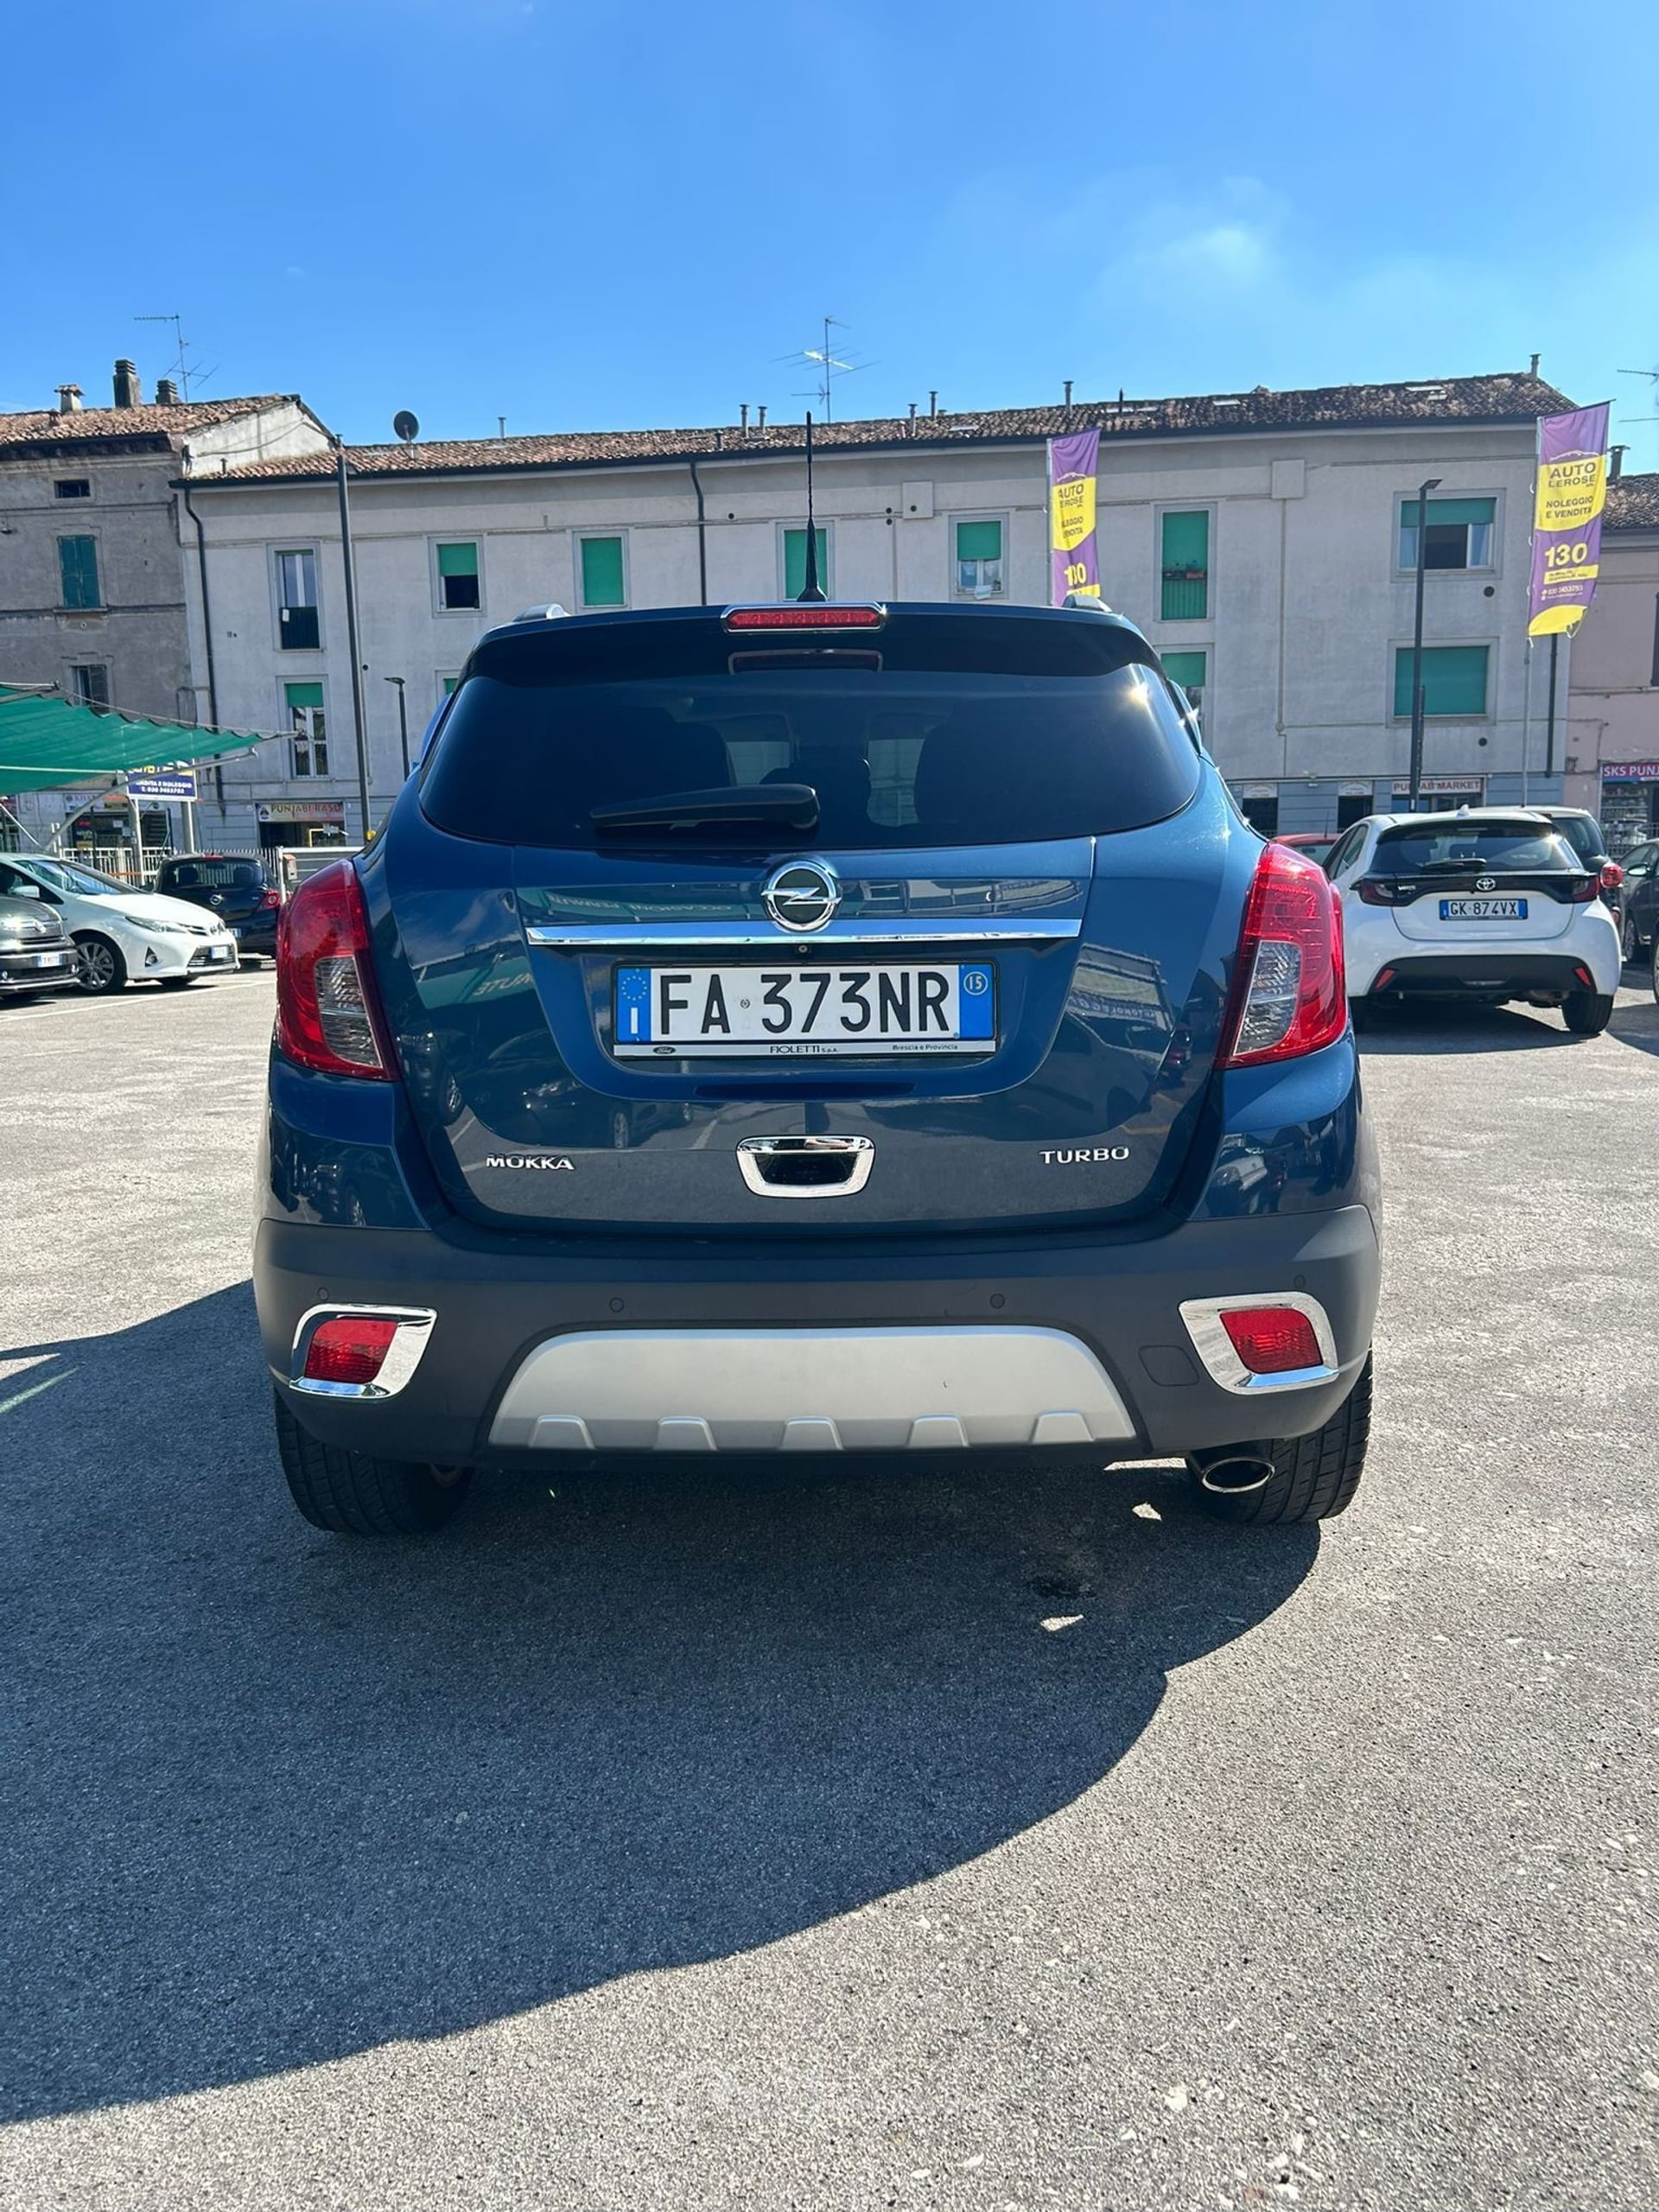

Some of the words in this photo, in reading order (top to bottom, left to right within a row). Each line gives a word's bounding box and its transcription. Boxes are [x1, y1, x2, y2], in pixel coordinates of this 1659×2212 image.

[1549, 461, 1596, 480] AUTO
[1548, 474, 1596, 488] LEROSE
[1546, 494, 1594, 509] NOLEGGIO
[1546, 511, 1552, 519] E
[1554, 506, 1592, 518] VENDITA
[1545, 543, 1588, 568] 130
[1603, 766, 1626, 777] SKS
[1437, 779, 1480, 790] MARKET
[270, 804, 311, 813] PUNJABI
[1450, 902, 1467, 916] GK
[1473, 901, 1517, 916] 874VX
[969, 975, 982, 989] 15
[660, 974, 731, 1034] FA
[760, 972, 950, 1033] 373NR
[486, 1154, 574, 1170] MOKKA
[1039, 1146, 1129, 1164] TURBO
